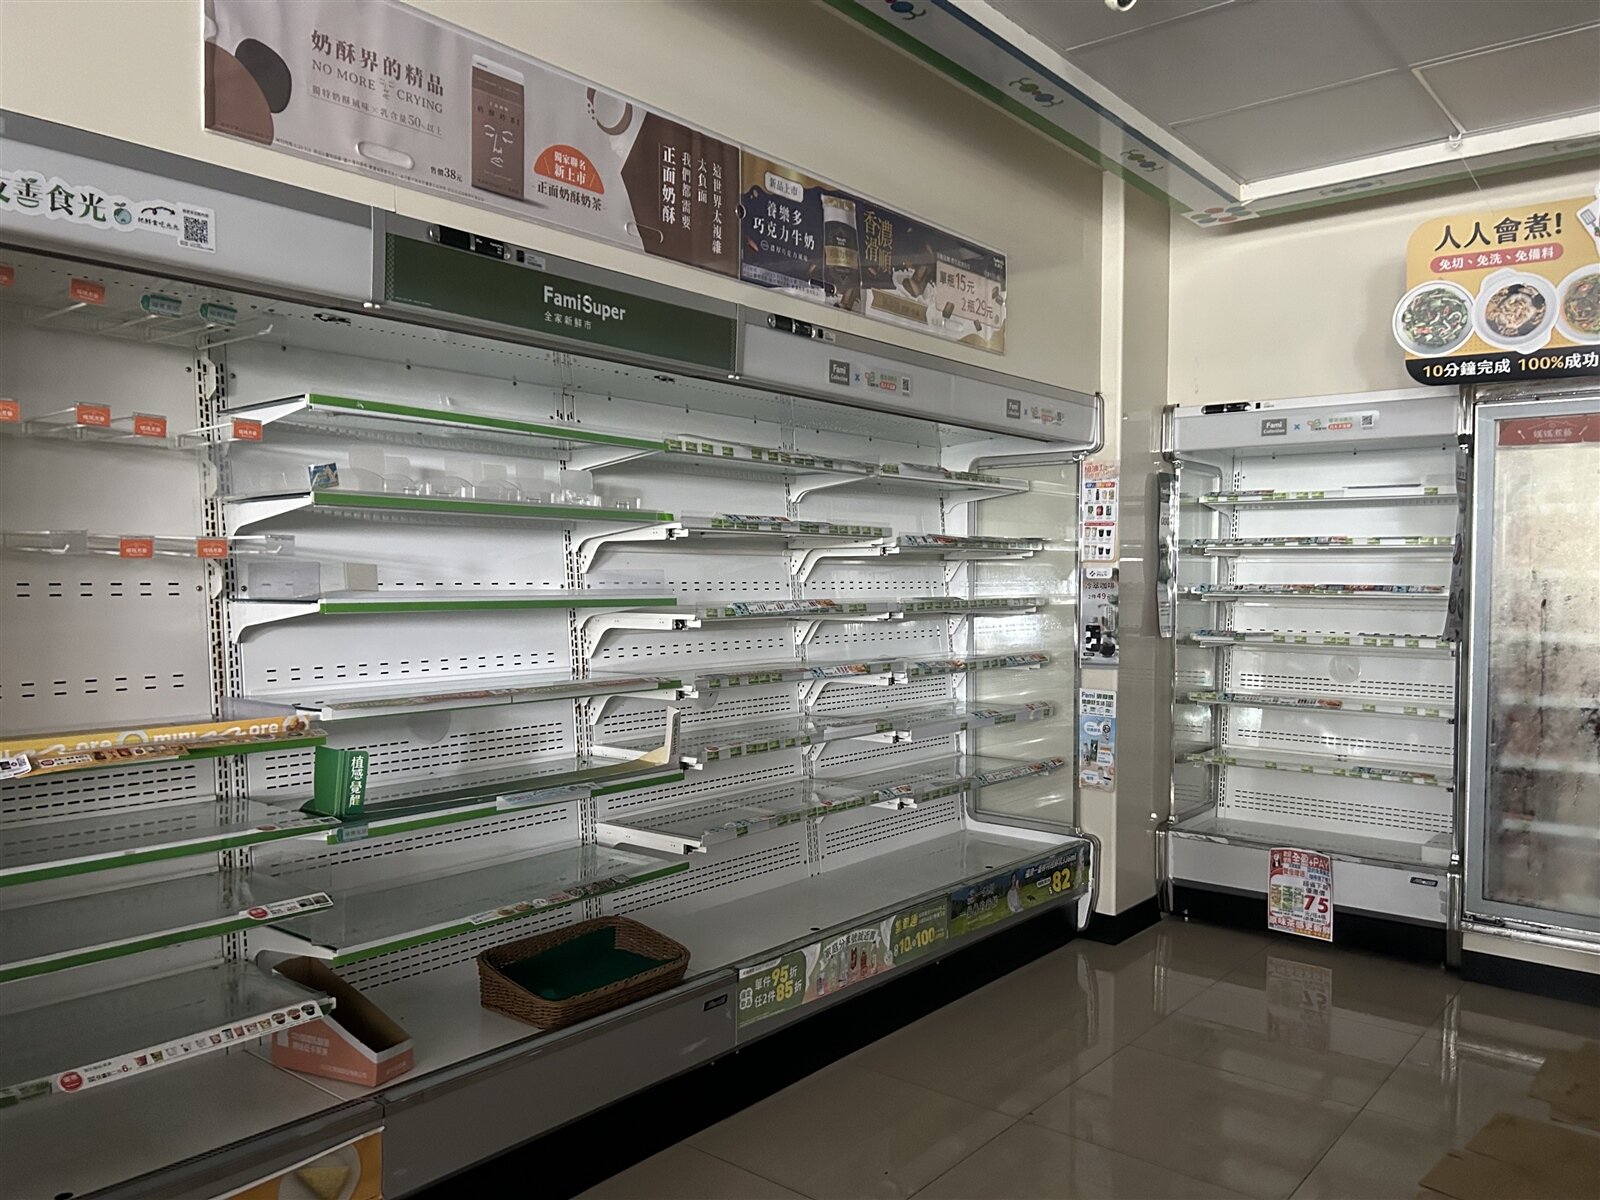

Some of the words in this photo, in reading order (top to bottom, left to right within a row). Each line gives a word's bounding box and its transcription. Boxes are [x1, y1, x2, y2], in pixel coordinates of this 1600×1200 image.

[311, 29, 444, 97] 奶酥界的精品
[312, 59, 333, 76] NO
[337, 65, 376, 92] MORE
[396, 88, 444, 114] CRYING
[430, 164, 463, 183] 售價38元
[553, 150, 587, 171] 獨家聯名
[553, 162, 587, 185] 新上市
[662, 145, 676, 226] 正面奶酥
[681, 151, 692, 231] 我們都需要
[697, 157, 708, 205] 太負面
[768, 175, 799, 198] 新品上市
[537, 180, 603, 213] 正面奶酥奶茶
[712, 161, 723, 255] 這世界太複雜
[767, 199, 803, 226] 養樂多
[752, 216, 816, 251] 巧克力牛奶
[1434, 212, 1562, 252] 人人會煮!
[1438, 246, 1554, 271] 免切、免洗、免備料
[543, 285, 627, 322] FamiSuper
[961, 291, 994, 321] 2瓶29元
[543, 311, 593, 330] 全家新鮮市
[1422, 359, 1511, 379] 10分鐘完成
[1518, 351, 1599, 372] 100%成功
[1304, 894, 1329, 914] 75
[754, 962, 799, 991] 單件95折
[754, 978, 803, 1009] 任2件85折
